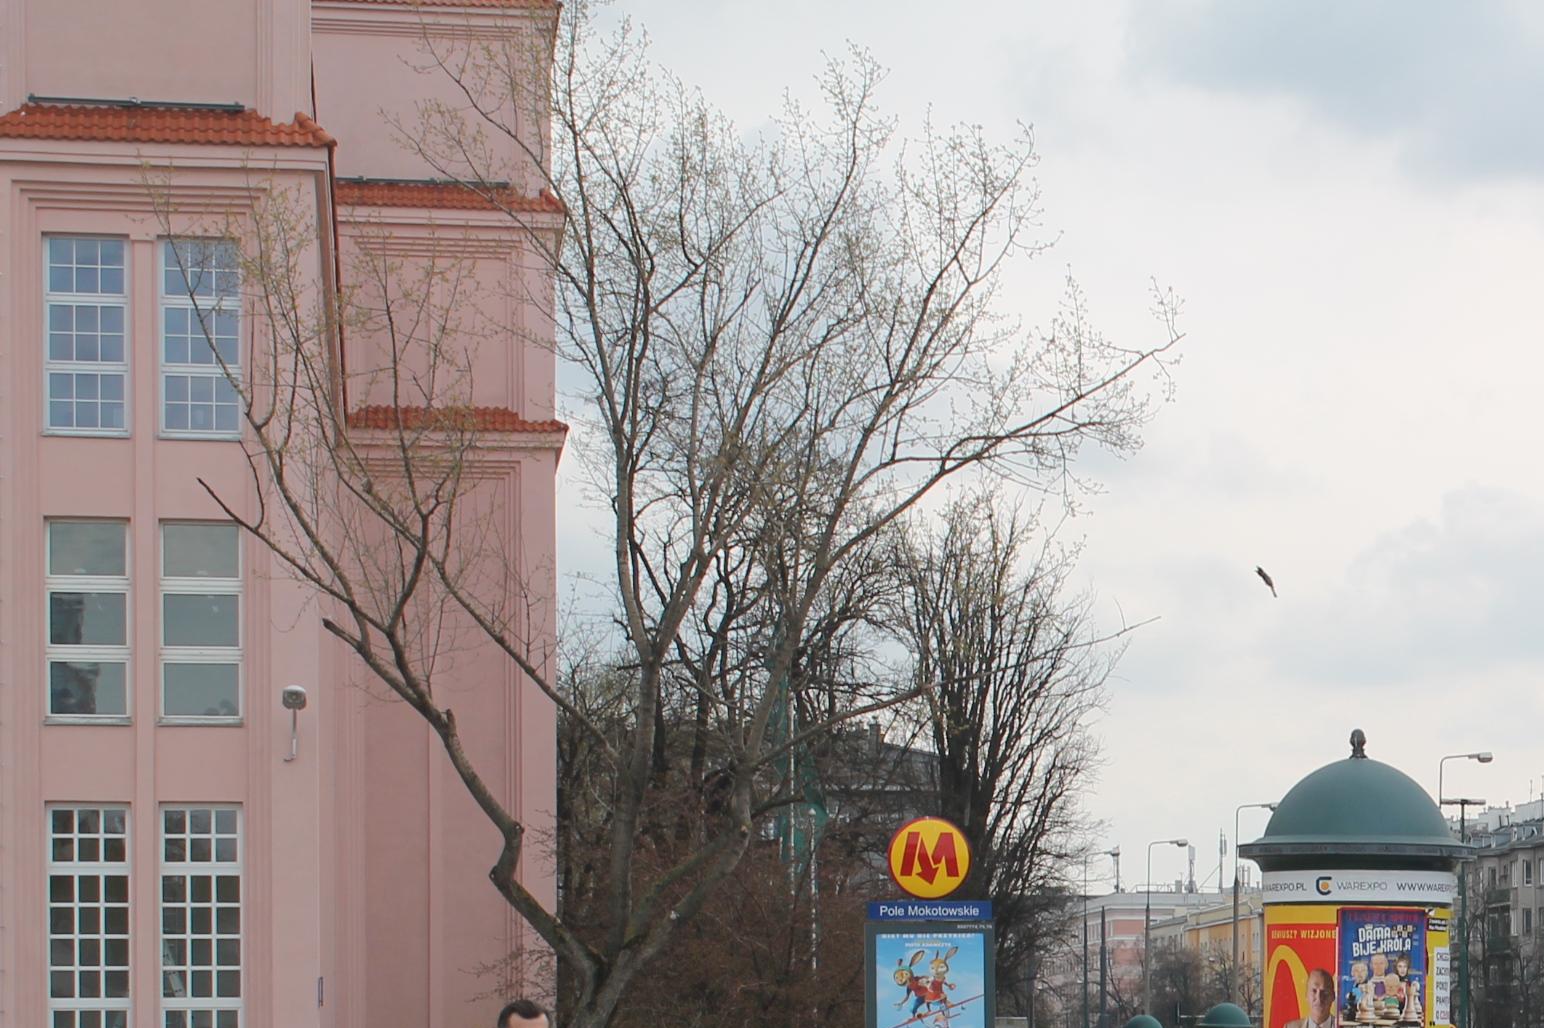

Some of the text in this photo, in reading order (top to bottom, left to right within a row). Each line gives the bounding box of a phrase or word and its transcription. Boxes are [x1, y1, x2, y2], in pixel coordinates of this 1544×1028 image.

[1336, 881, 1388, 891] WAREXPO
[880, 905, 980, 917] Pole Mokotowskie
[1358, 926, 1391, 942] DAMA
[1352, 940, 1378, 957] BIJE
